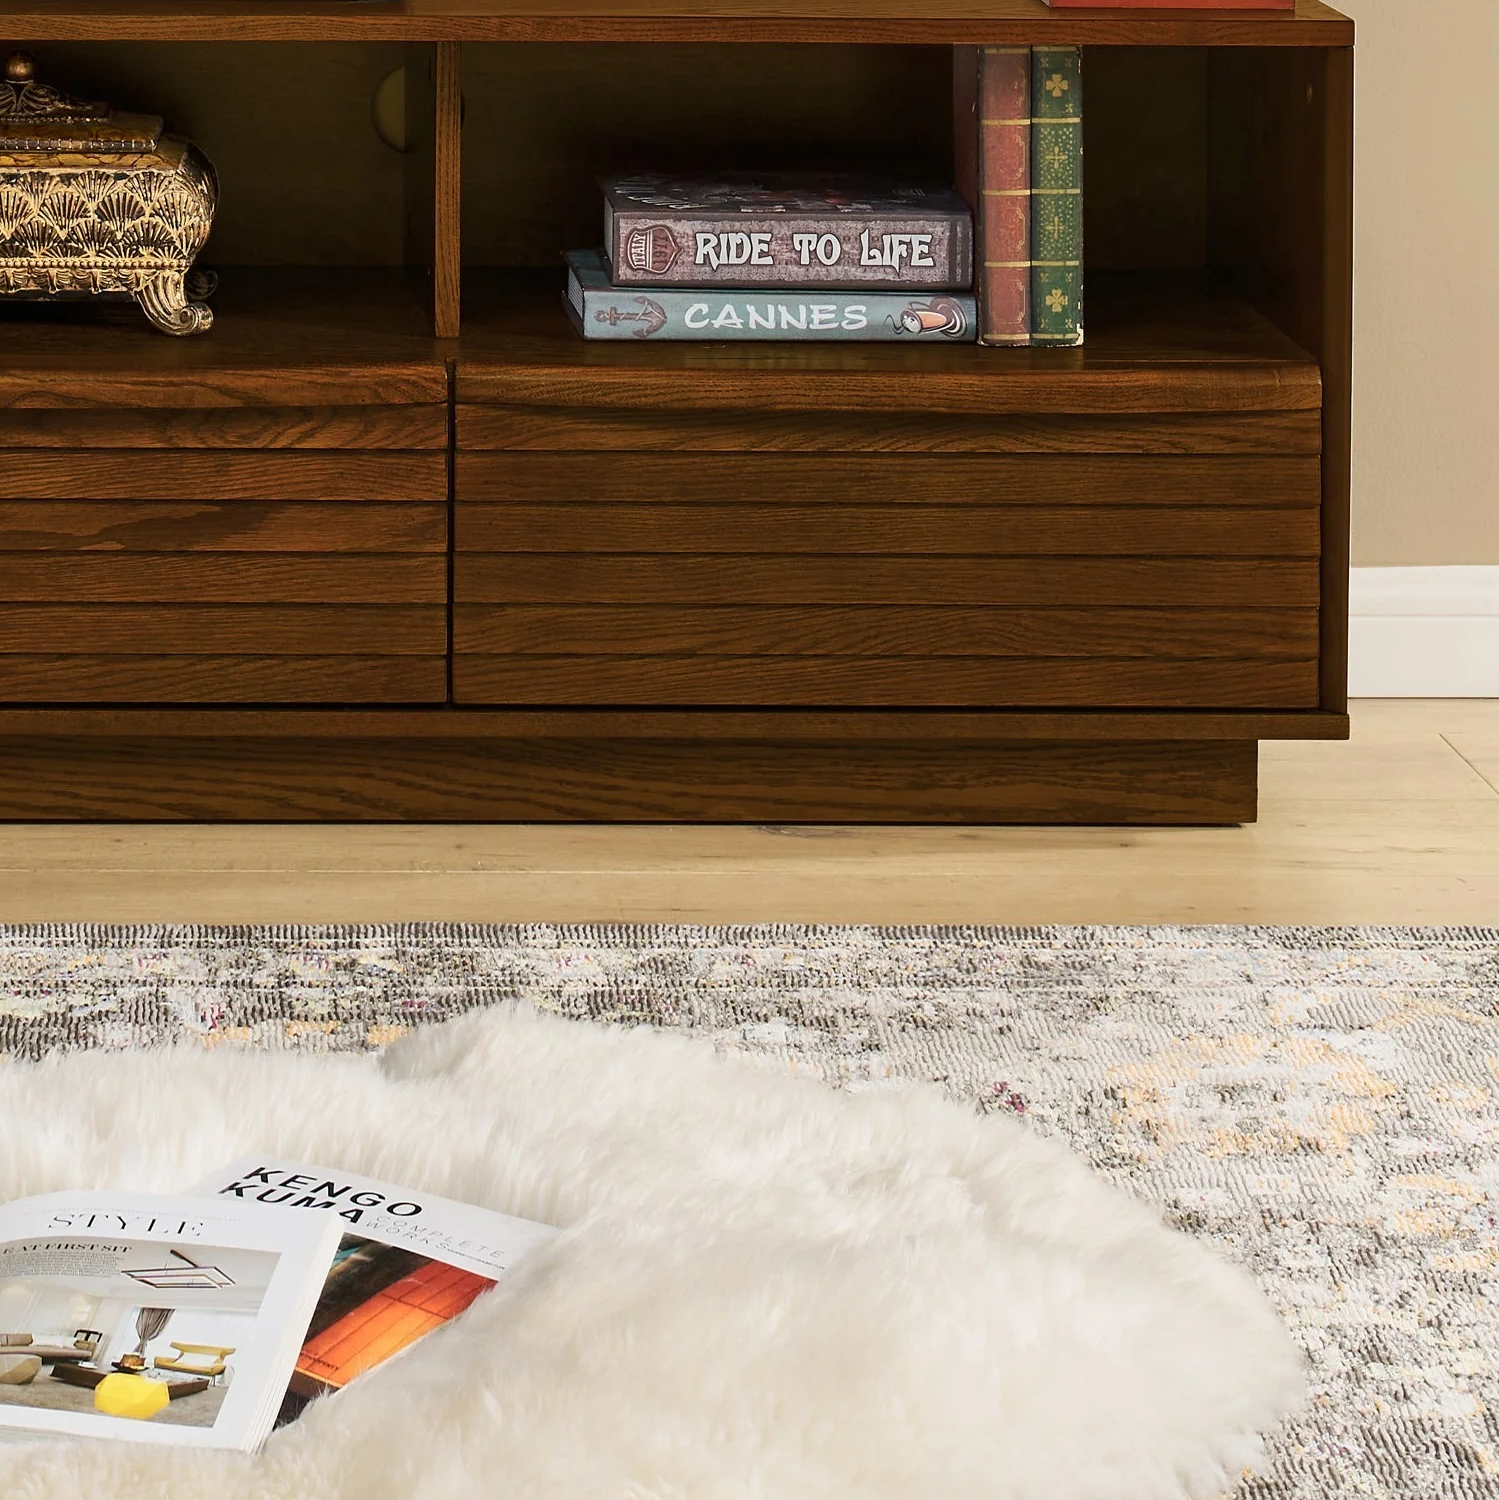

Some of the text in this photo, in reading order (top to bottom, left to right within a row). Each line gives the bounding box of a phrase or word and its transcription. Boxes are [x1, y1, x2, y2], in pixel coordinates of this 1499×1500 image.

[631, 233, 646, 266] ITALY
[695, 232, 775, 271] RIDE
[792, 233, 842, 267] TO
[860, 229, 934, 277] LIFE
[684, 303, 868, 331] CANNES
[218, 1181, 364, 1225] KUMA
[243, 1166, 423, 1217] KENGO
[48, 1213, 204, 1237] STYLE
[366, 1221, 449, 1251] WORKS
[376, 1215, 507, 1260] COMPLETE
[45, 1243, 99, 1251] FIRST
